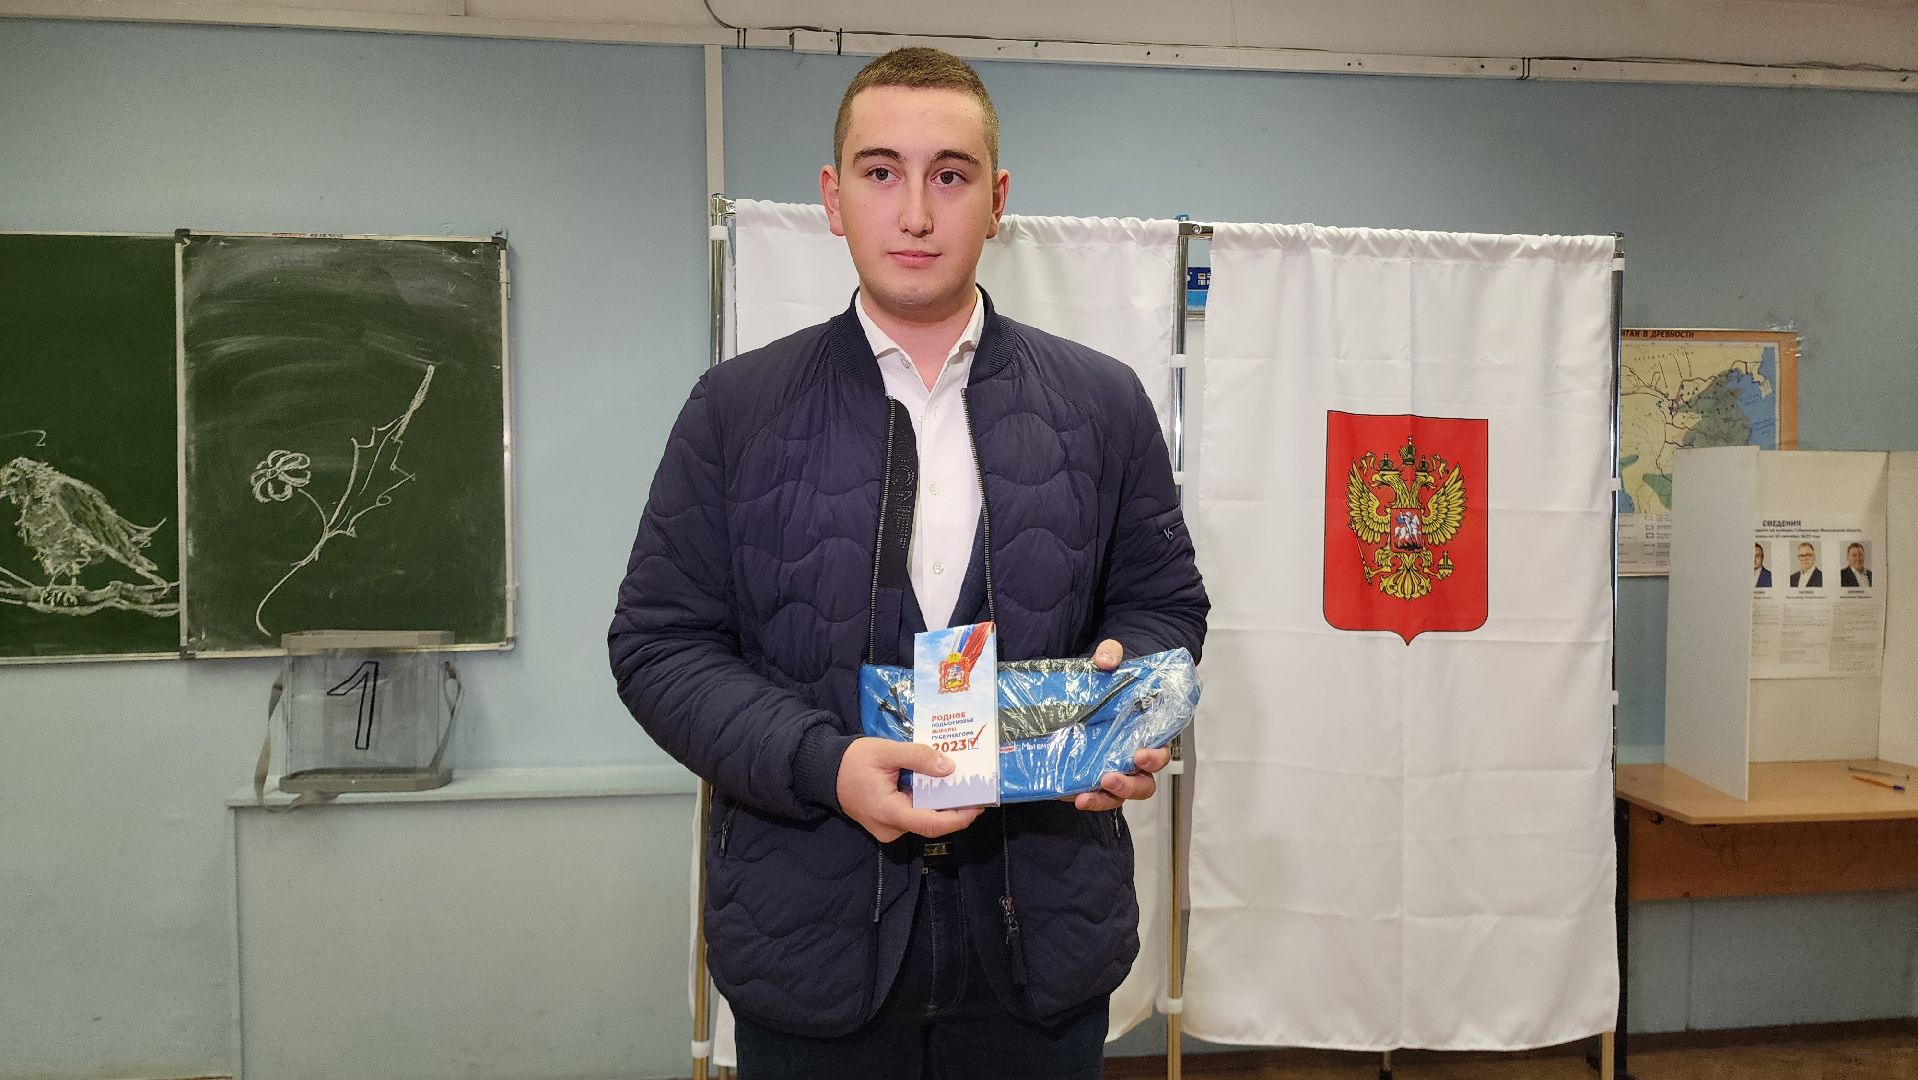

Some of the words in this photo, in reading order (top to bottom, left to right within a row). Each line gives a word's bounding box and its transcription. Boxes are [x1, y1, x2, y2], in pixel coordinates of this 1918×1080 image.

[1643, 330, 1649, 338] В
[1650, 330, 1694, 339] ДРЕВНОСТИ
[1762, 520, 1801, 528] СВЕДЕНИЯ
[326, 660, 379, 750] 1
[931, 712, 966, 722] РОДНОЕ
[931, 718, 974, 728] ПОДМОСКОВЬЕ
[931, 727, 957, 735] ВЫБОРЫ
[931, 731, 974, 740] ГУБЕРНАТОРА
[931, 739, 967, 752] 2023
